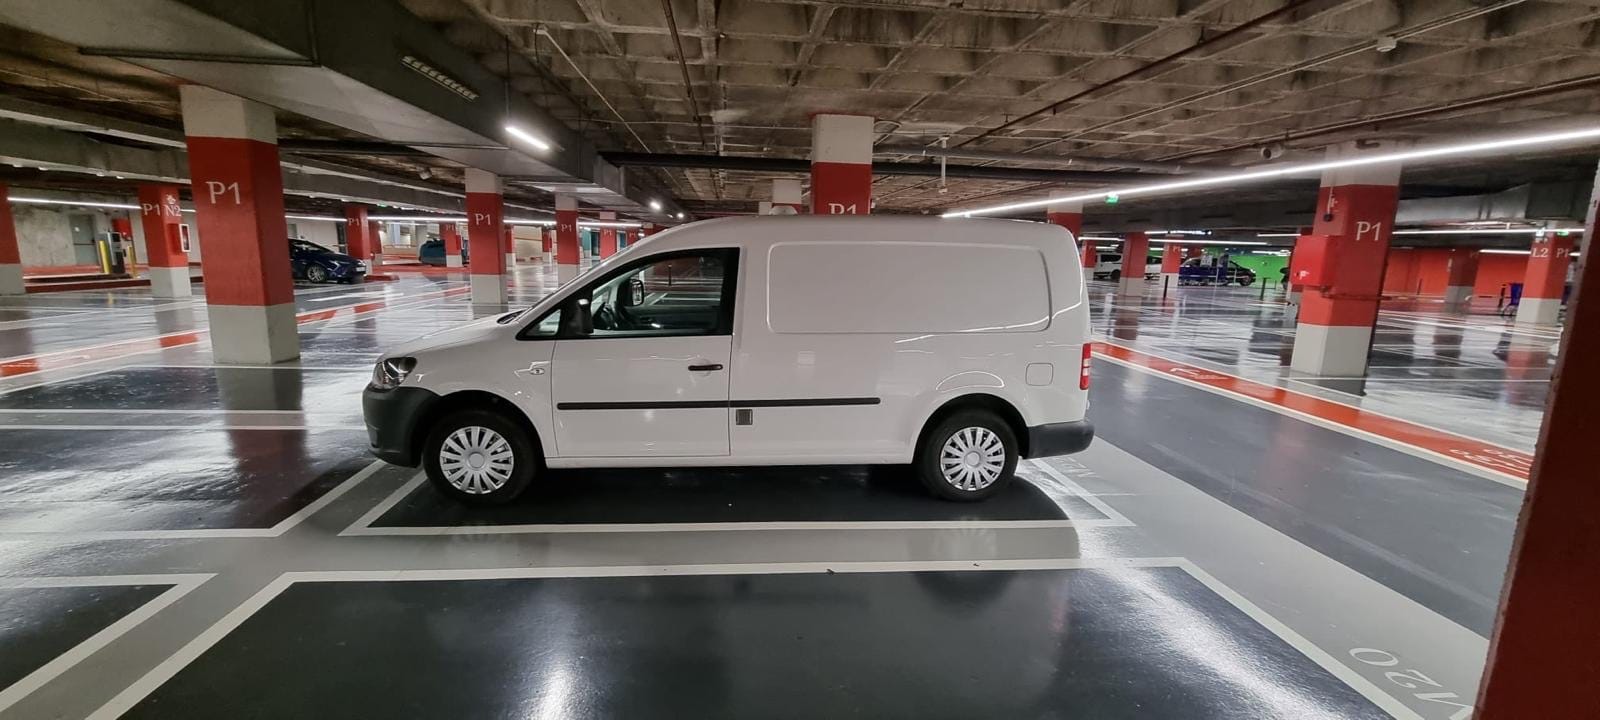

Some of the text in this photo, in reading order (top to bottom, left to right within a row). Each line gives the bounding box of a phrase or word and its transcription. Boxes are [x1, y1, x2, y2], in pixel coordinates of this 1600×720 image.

[206, 181, 241, 205] P1
[142, 203, 161, 216] P1
[163, 204, 182, 216] N2
[348, 217, 360, 226] P1
[475, 213, 492, 226] P1
[561, 224, 572, 232] P1
[1356, 221, 1382, 241] P1
[1531, 248, 1549, 258] L2
[1555, 248, 1569, 258] P1
